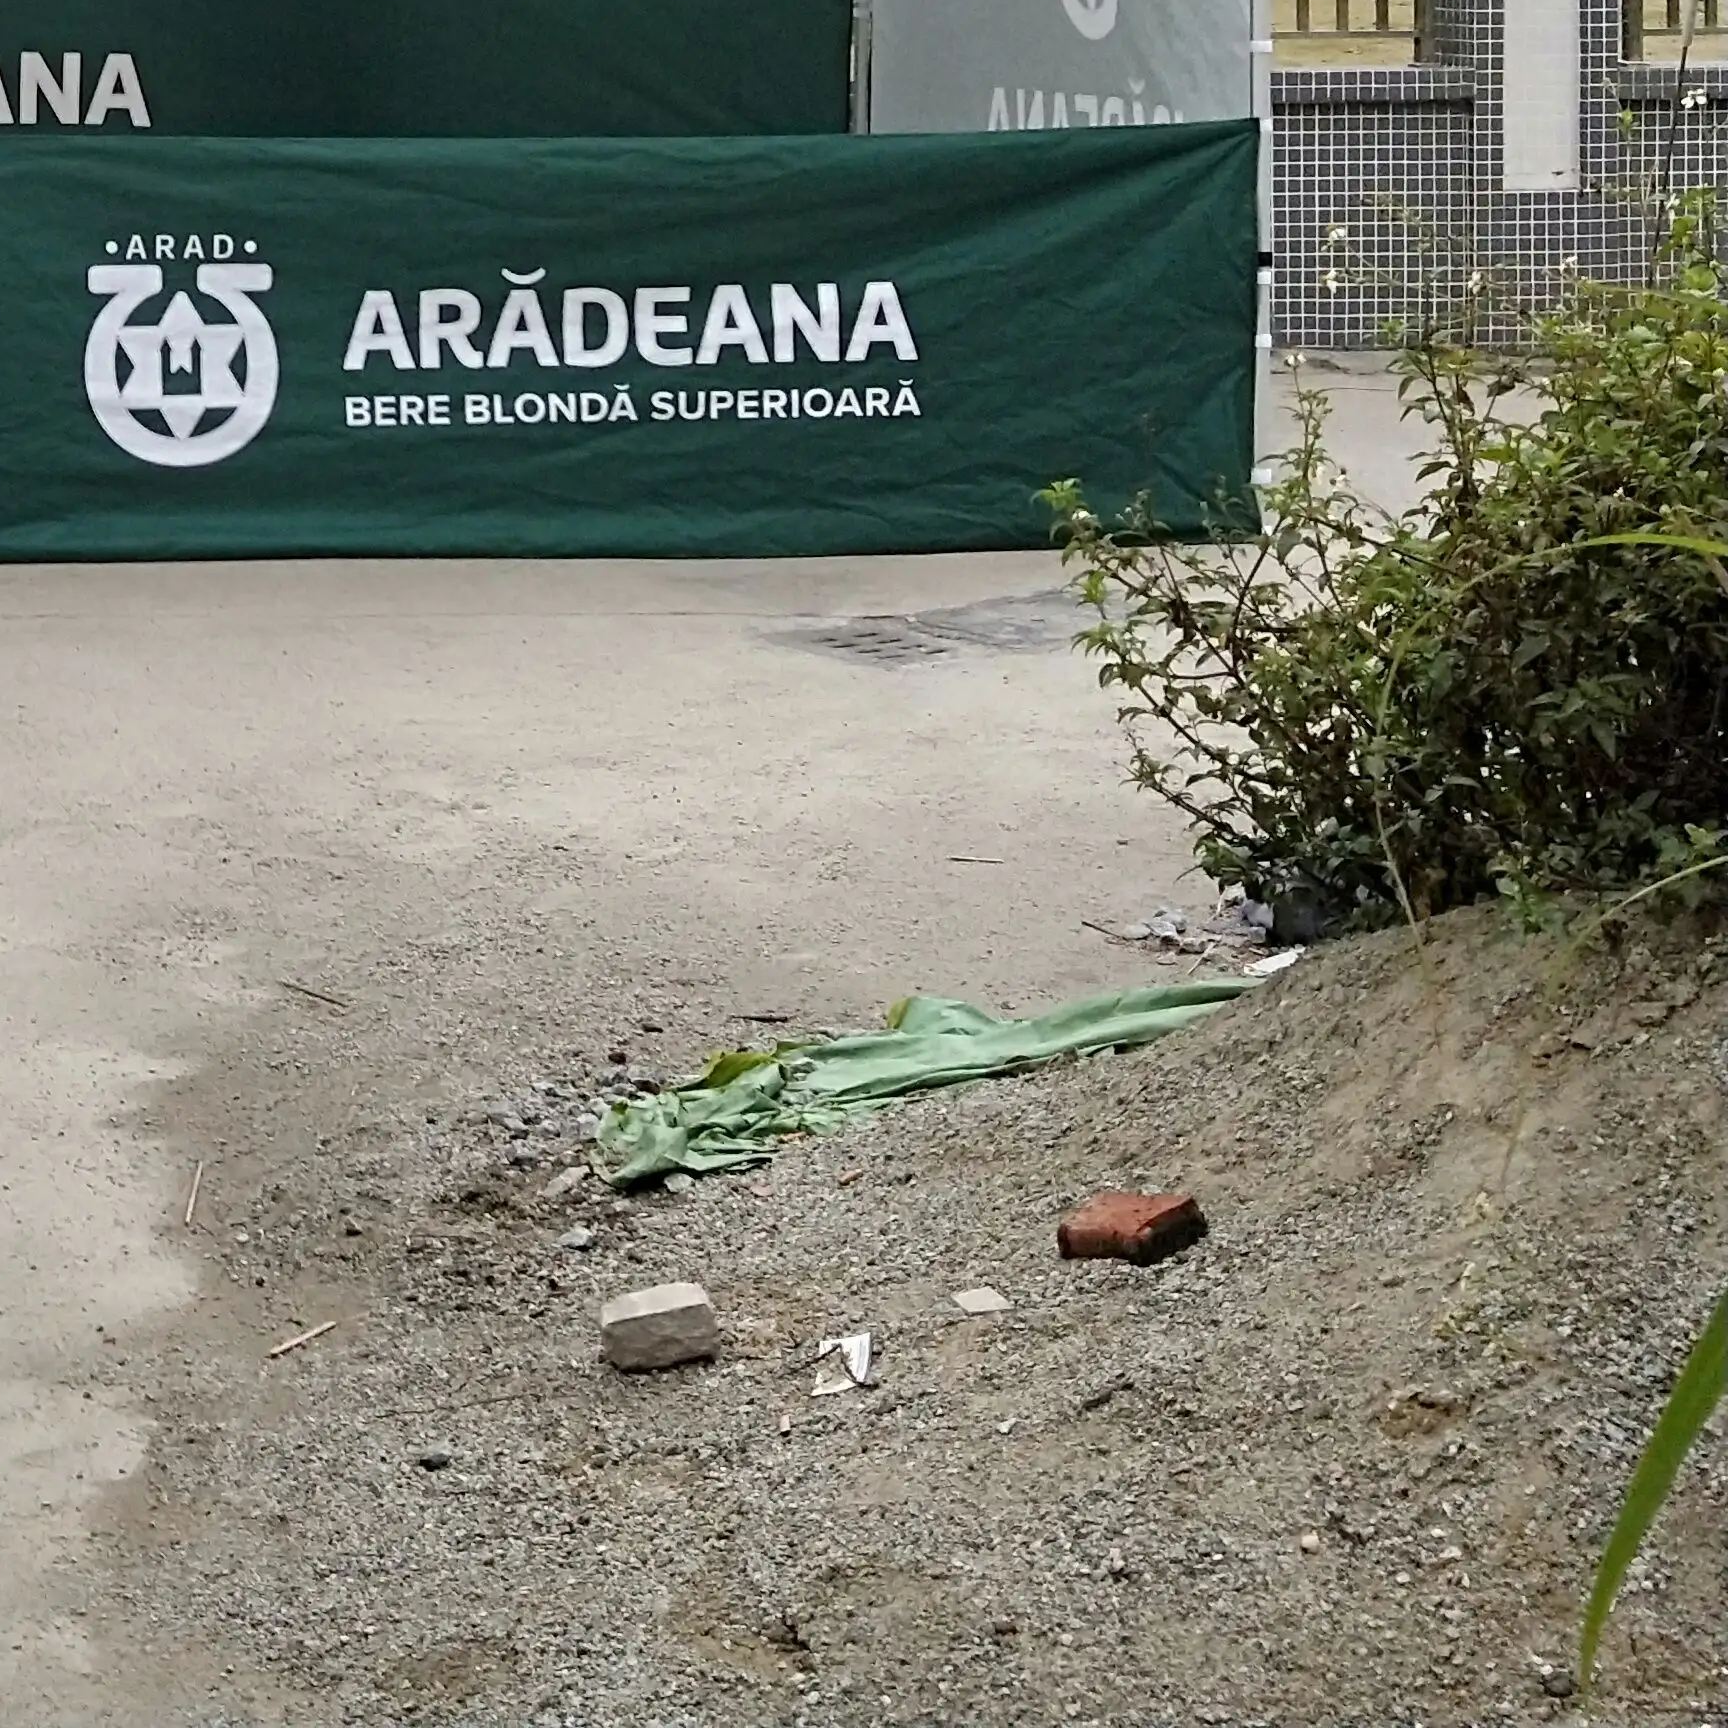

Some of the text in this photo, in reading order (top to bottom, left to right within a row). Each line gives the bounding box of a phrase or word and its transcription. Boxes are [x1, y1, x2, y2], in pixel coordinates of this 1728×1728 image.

[125, 234, 234, 260] ARAD
[342, 266, 920, 372] ARĂDEANA
[345, 378, 922, 427] BERE BLONDĂ SUPERIOARĂ
